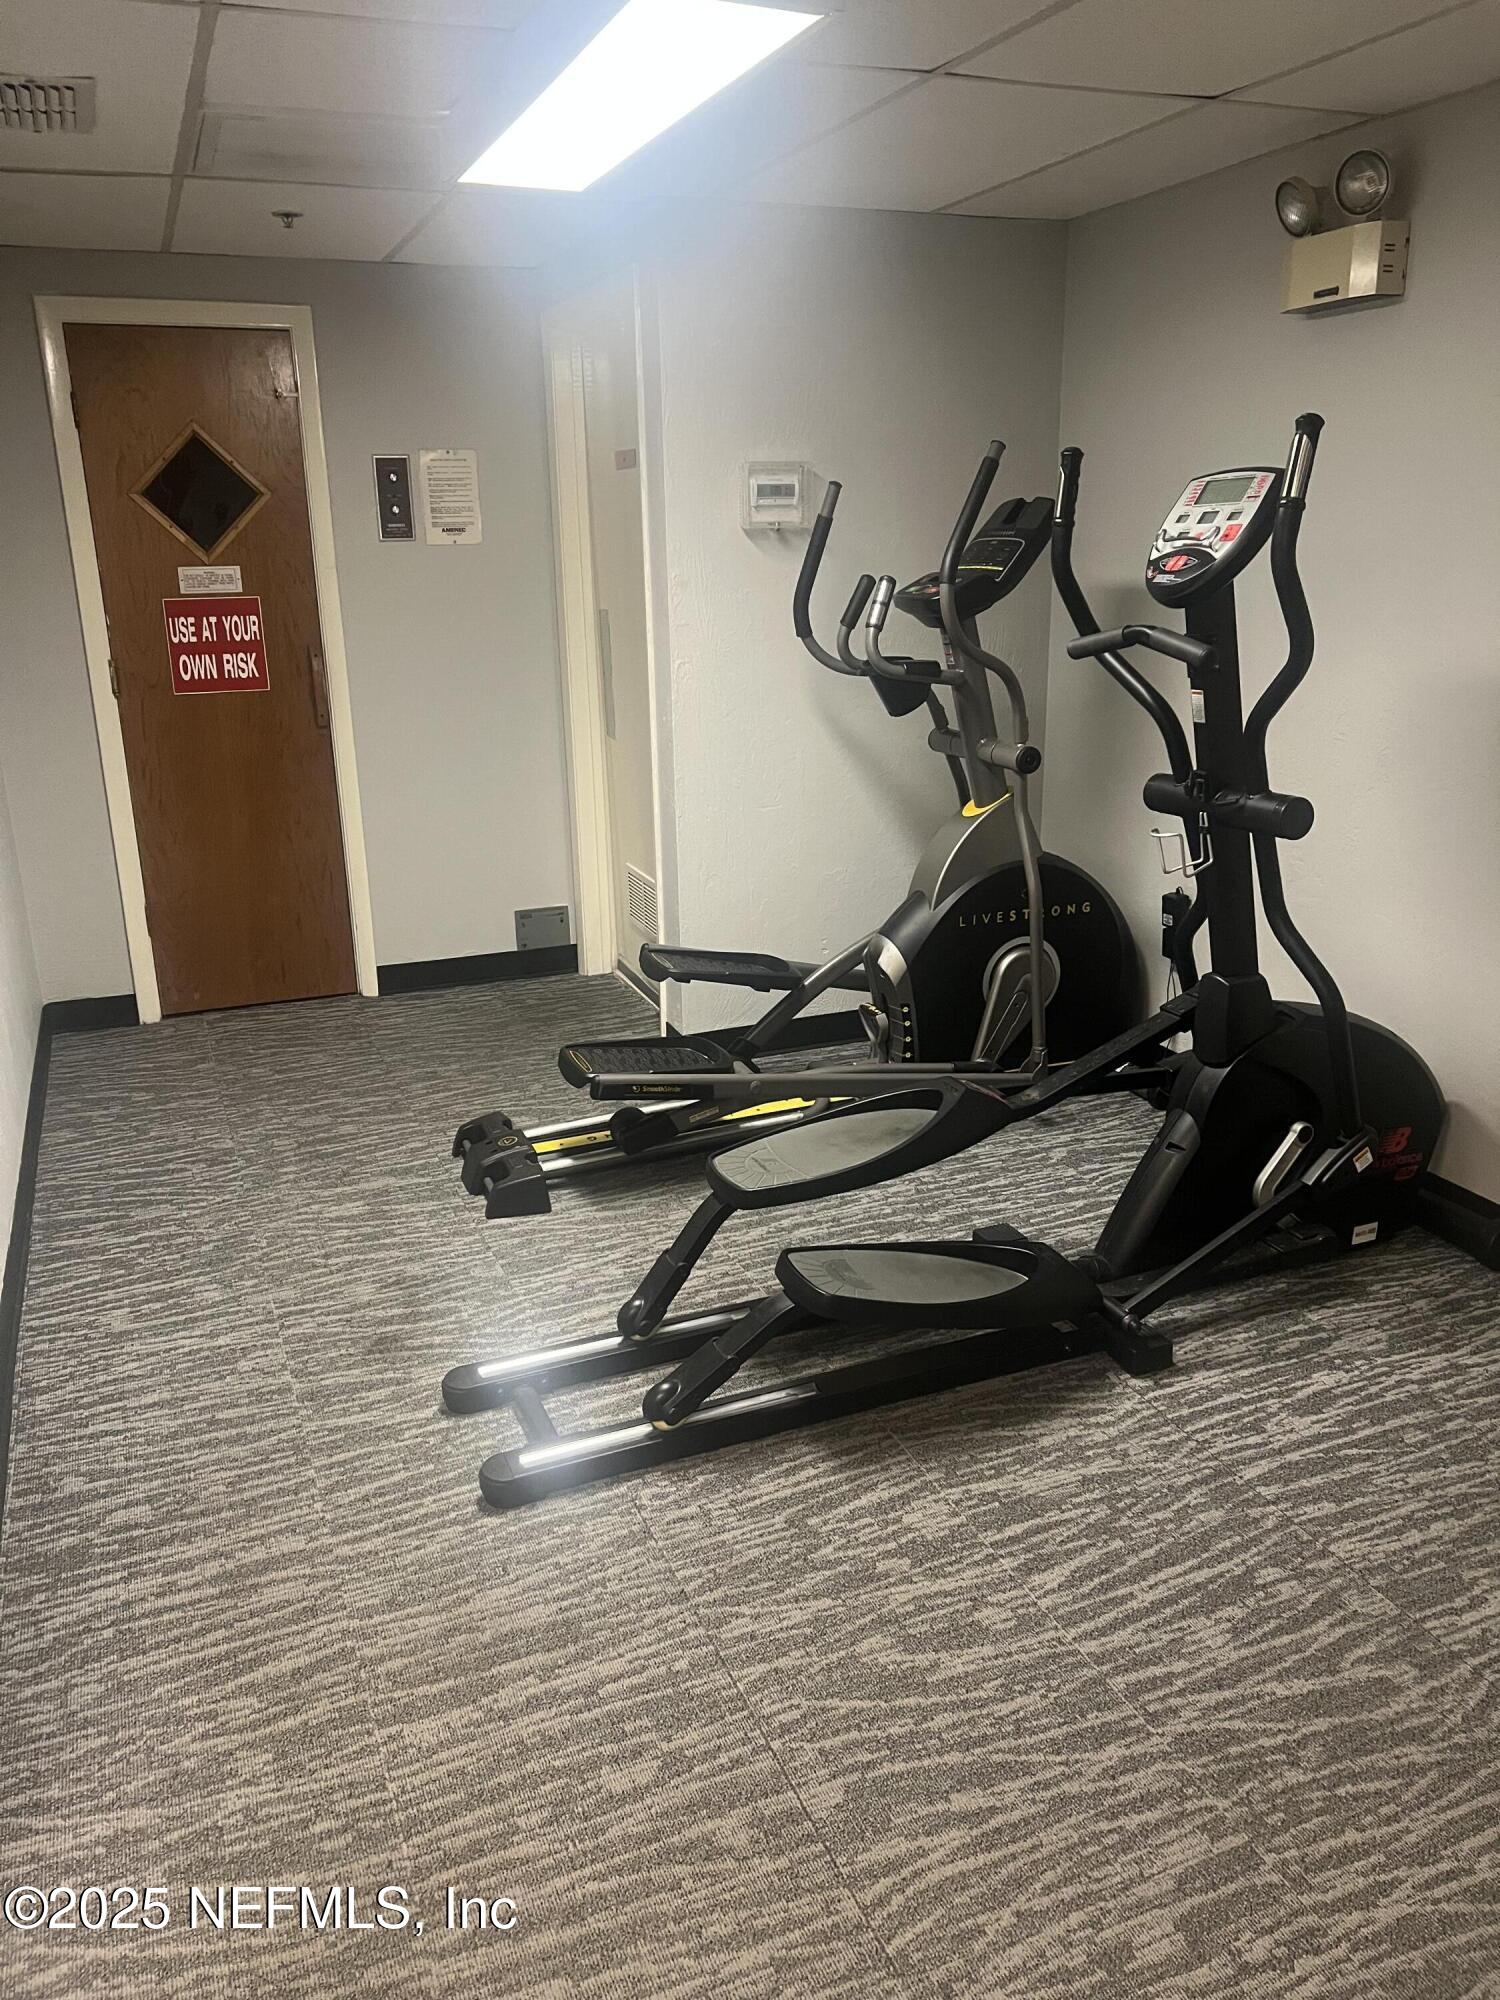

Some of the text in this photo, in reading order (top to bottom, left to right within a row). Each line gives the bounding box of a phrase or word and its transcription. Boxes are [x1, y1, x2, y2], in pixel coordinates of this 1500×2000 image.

[168, 614, 260, 643] USE AT YOUR
[179, 652, 260, 680] OWN RISK
[959, 902, 1091, 927] LIVESTONG
